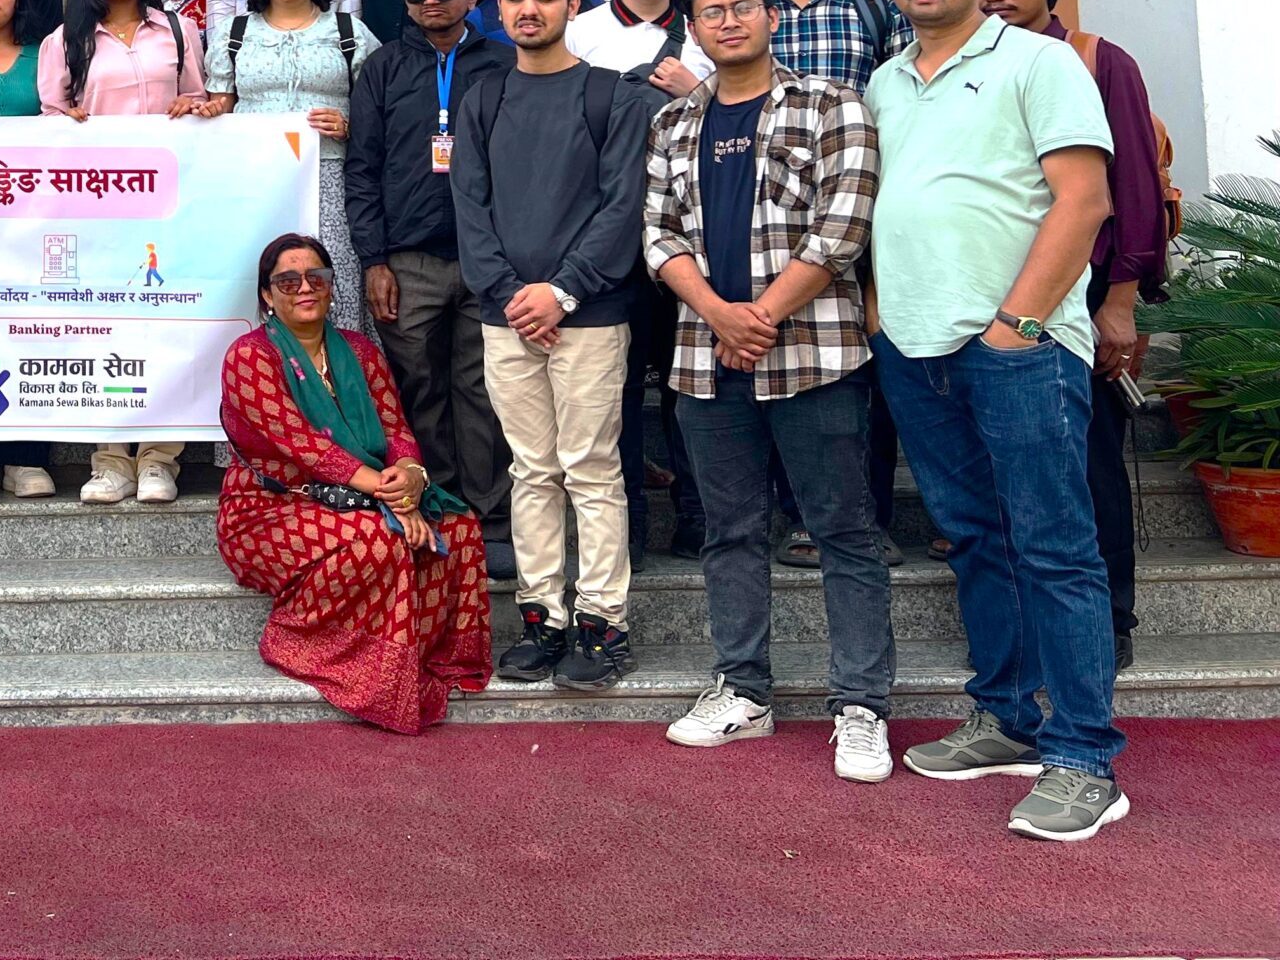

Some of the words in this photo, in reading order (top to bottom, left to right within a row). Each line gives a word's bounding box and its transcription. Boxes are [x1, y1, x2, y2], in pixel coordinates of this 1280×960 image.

[47, 168, 159, 199] साक्षरता
[40, 288, 94, 303] "समावेशी
[96, 292, 126, 303] अक्षर
[128, 292, 136, 303] र
[138, 292, 203, 307] अनुसन्धान"
[8, 324, 61, 337] Banking
[64, 324, 113, 335] Partner
[19, 358, 96, 376] कामना
[103, 353, 147, 378] सेवा
[19, 381, 55, 394] विकास
[19, 397, 54, 407] Kamana
[56, 397, 79, 407] Sewa
[81, 397, 104, 407] Bikas
[106, 397, 128, 408] Bank
[130, 398, 147, 409] Ltd.
